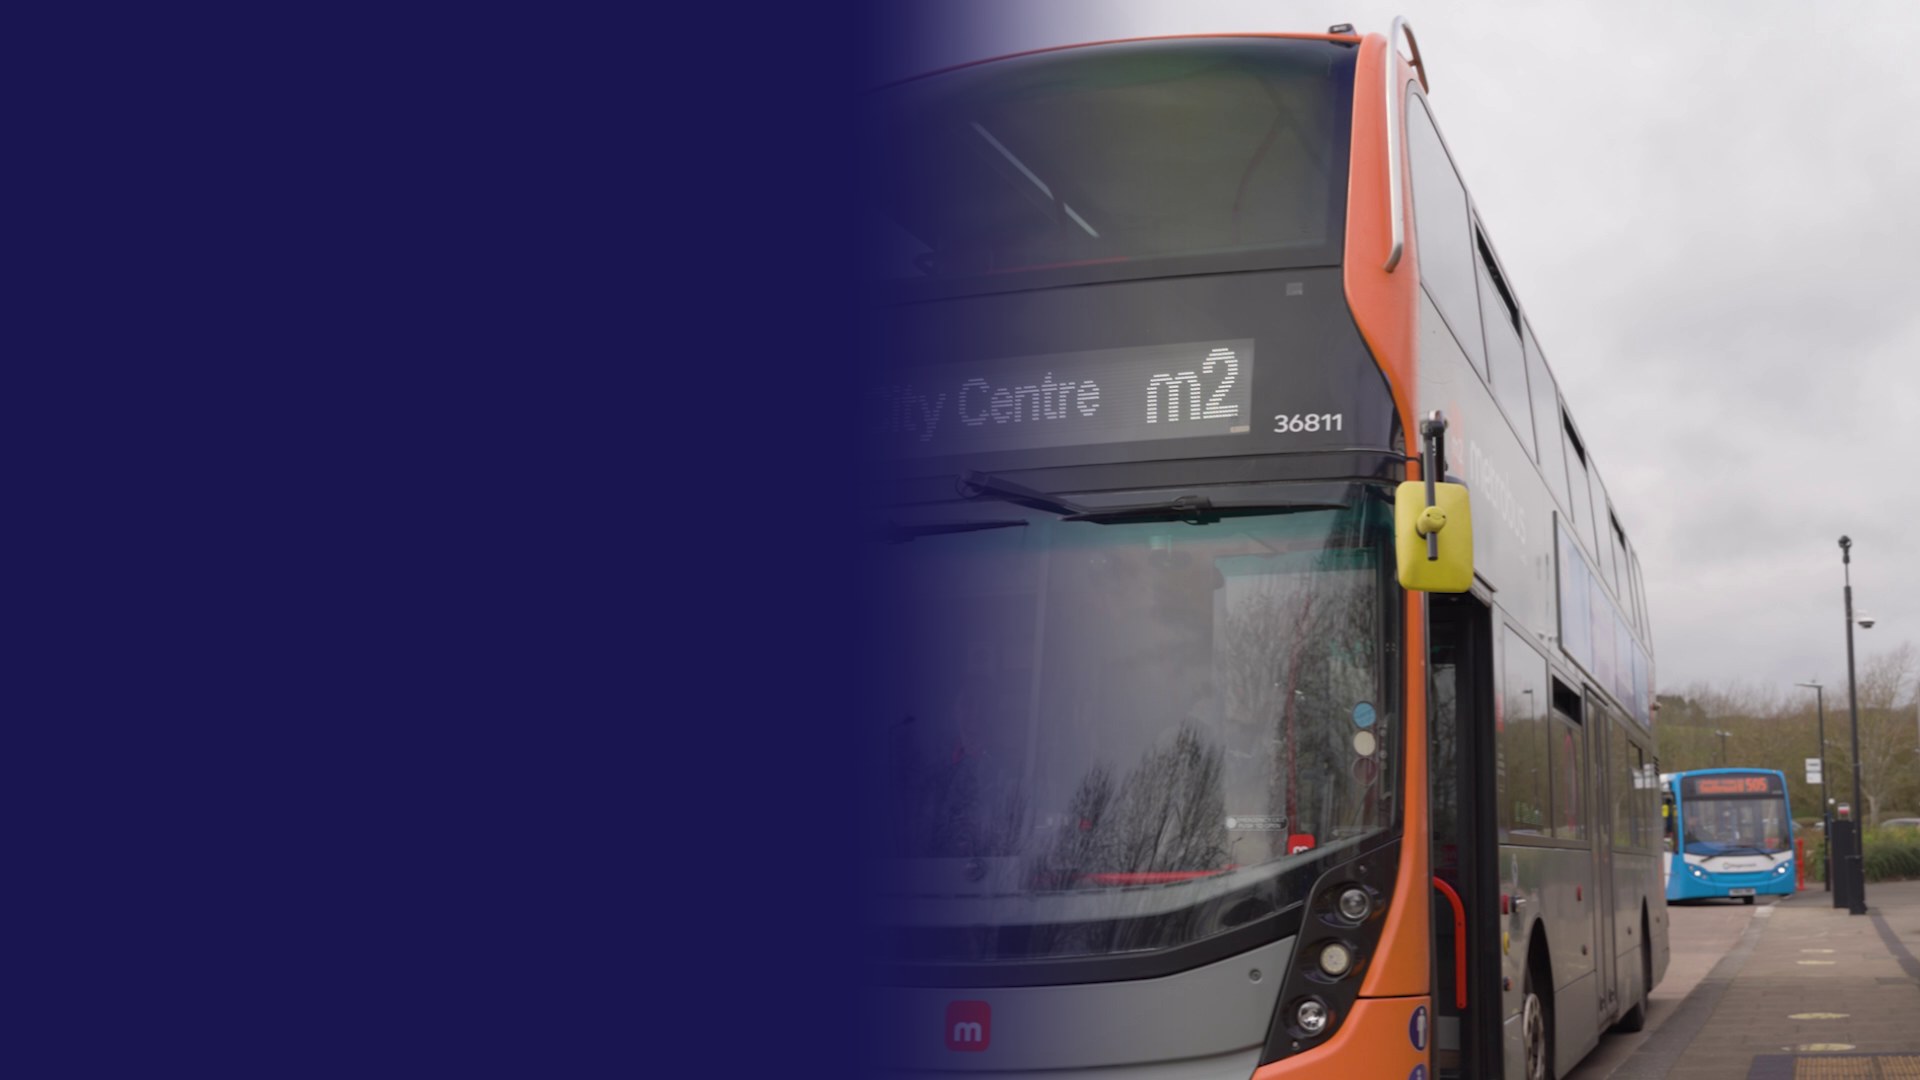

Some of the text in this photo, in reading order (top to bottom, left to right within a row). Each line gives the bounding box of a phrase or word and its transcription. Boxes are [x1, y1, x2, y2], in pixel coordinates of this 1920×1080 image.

[959, 372, 1100, 426] Centre
[1146, 348, 1239, 423] m2
[1273, 413, 1343, 433] 36811
[953, 1021, 982, 1042] m
